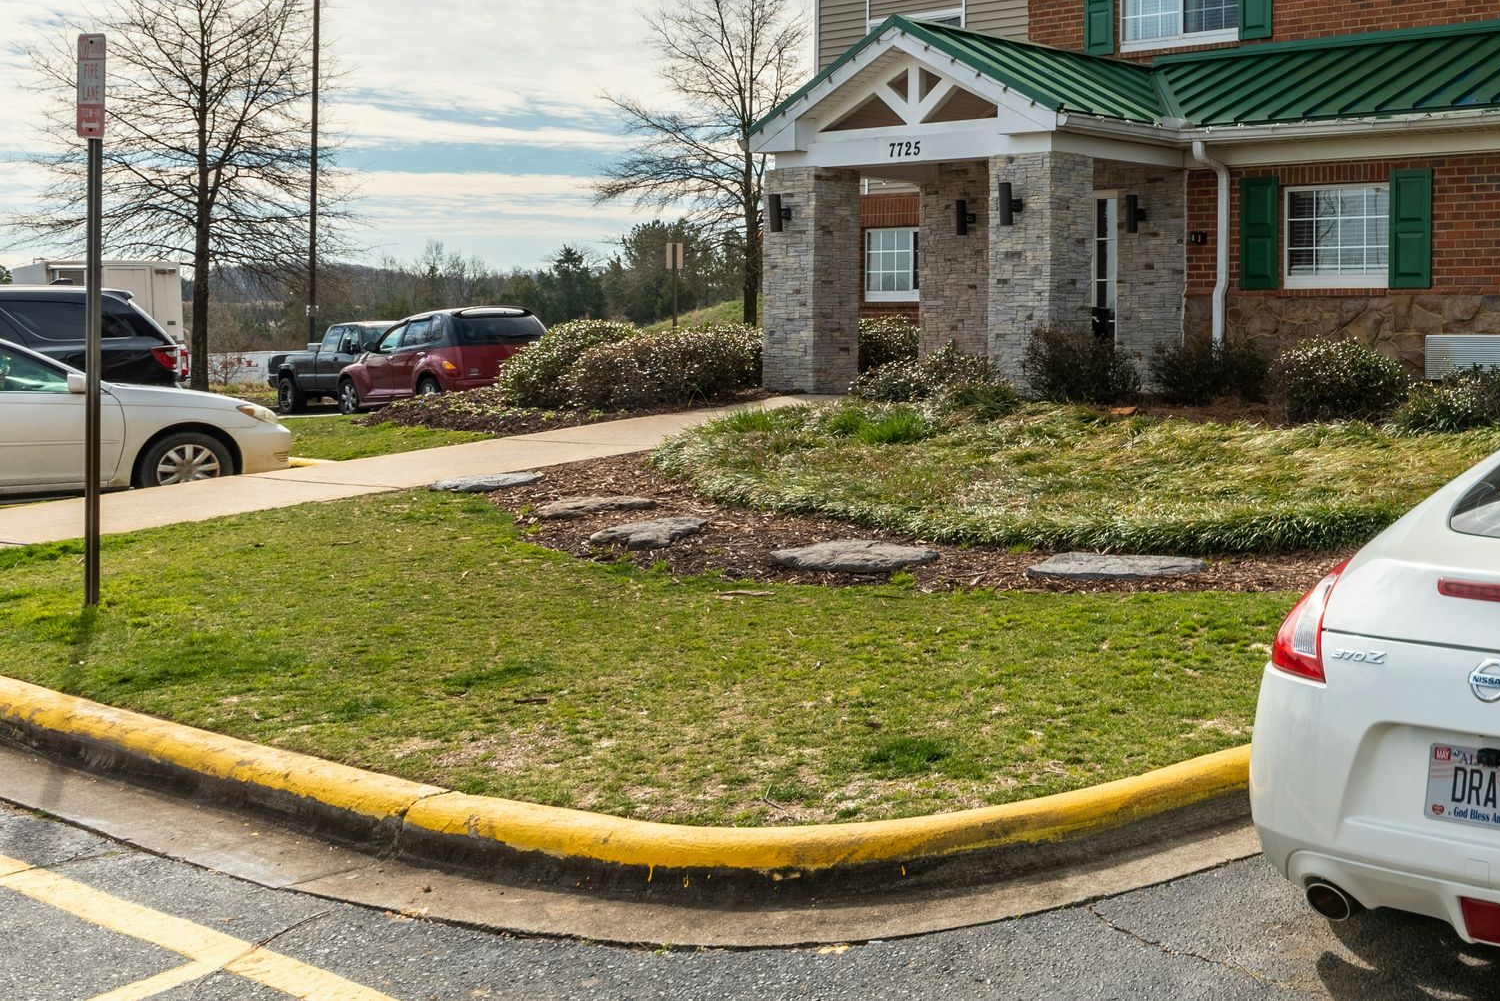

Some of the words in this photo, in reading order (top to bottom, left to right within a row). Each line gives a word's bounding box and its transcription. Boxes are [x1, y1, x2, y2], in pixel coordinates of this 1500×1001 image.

[84, 63, 99, 79] FIRE
[82, 85, 100, 101] LANE
[889, 140, 921, 158] 7725
[1331, 648, 1388, 665] 370Z
[1436, 748, 1450, 760] MAY
[1453, 806, 1469, 819] God
[1470, 810, 1490, 823] Bless
